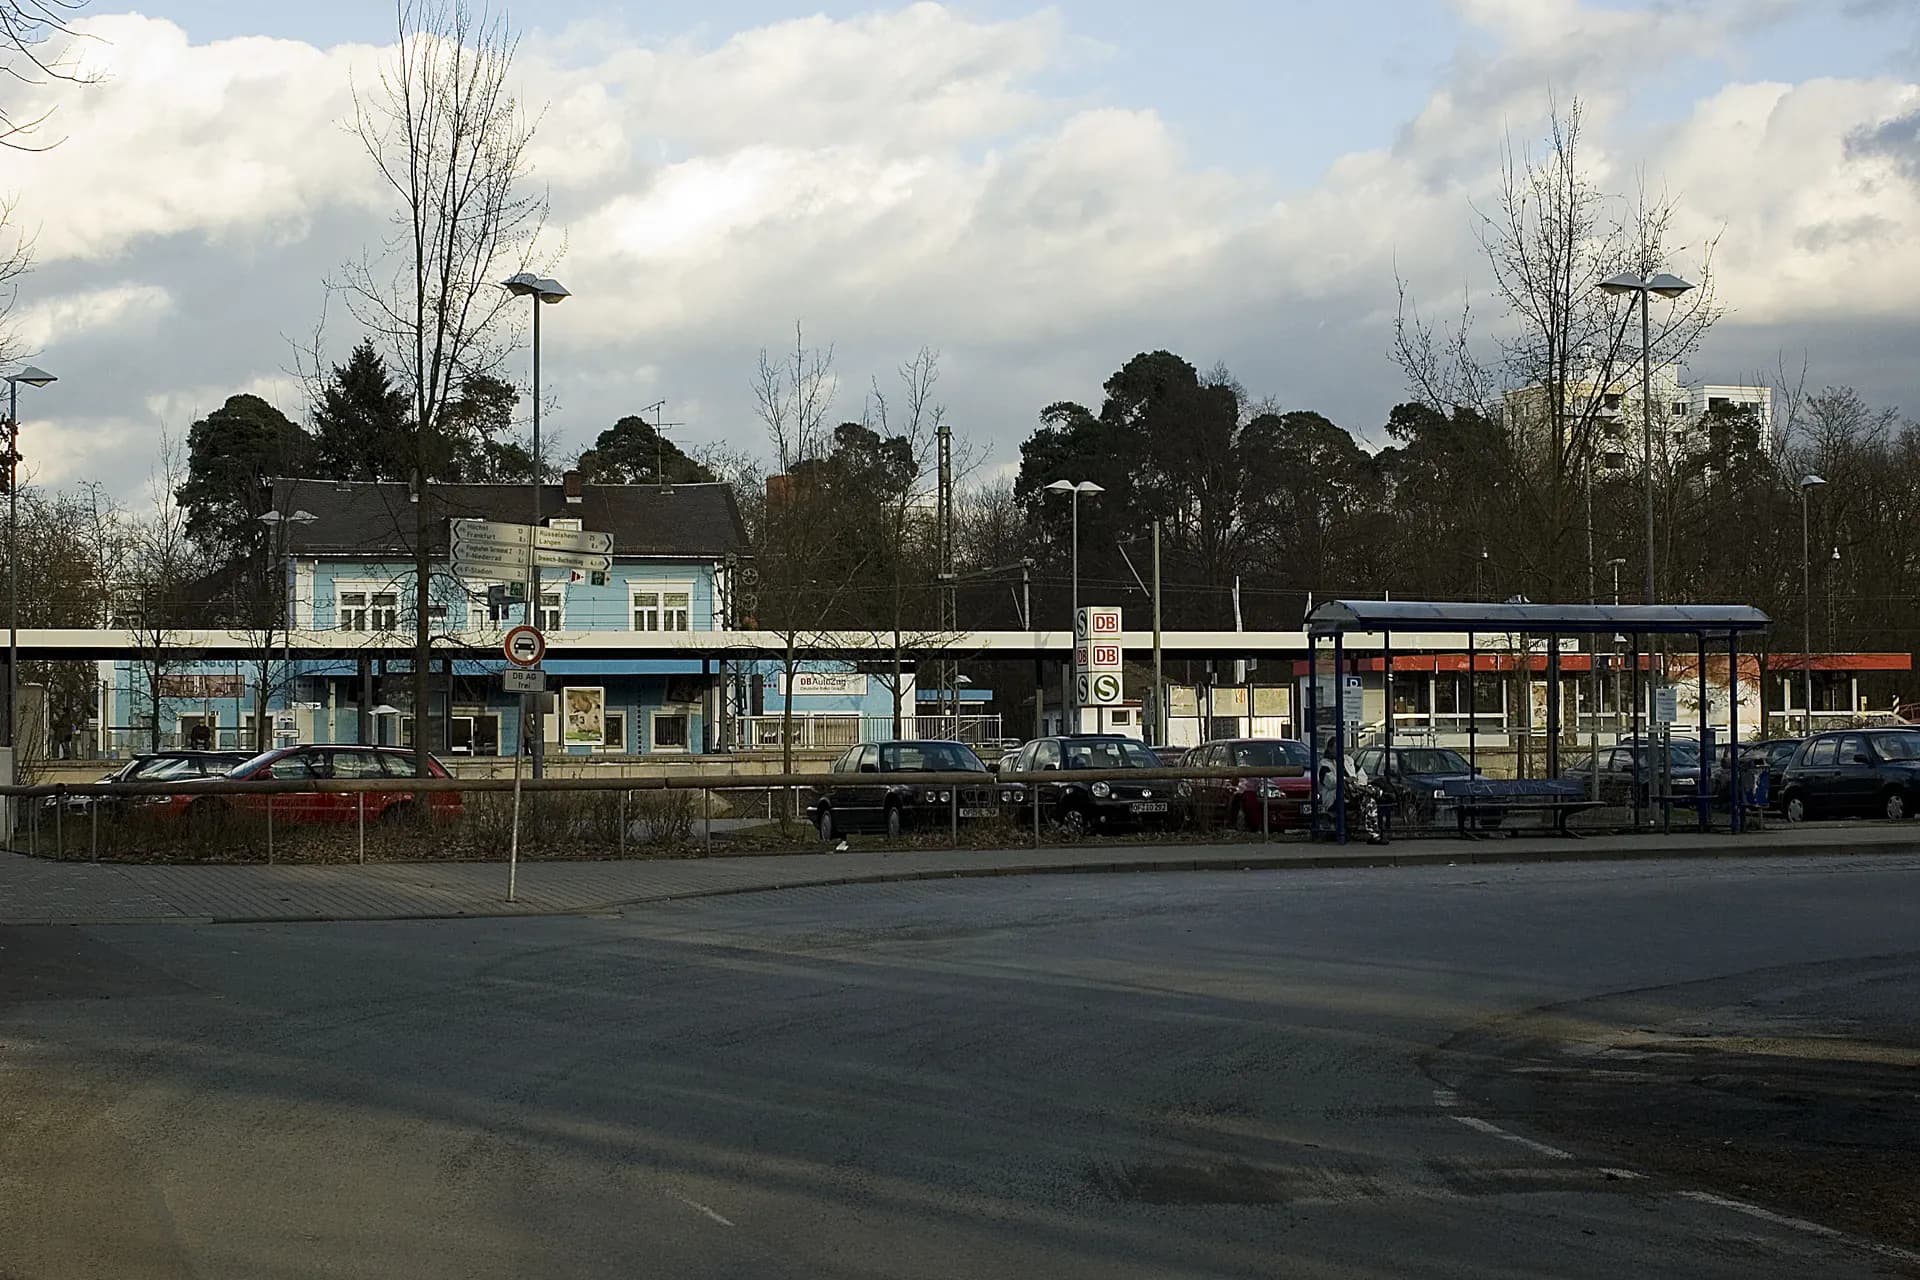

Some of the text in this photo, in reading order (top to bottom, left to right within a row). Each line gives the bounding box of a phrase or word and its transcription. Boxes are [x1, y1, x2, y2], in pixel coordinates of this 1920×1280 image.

[467, 531, 496, 540] Frankfurt
[540, 538, 561, 546] Langen
[1078, 611, 1087, 637] S
[1095, 616, 1115, 629] DB
[1078, 650, 1087, 663] DB
[1096, 649, 1116, 662] DB
[512, 672, 537, 680] DB AG
[518, 681, 531, 689] frei
[1078, 676, 1088, 701] S
[1097, 676, 1117, 700] S
